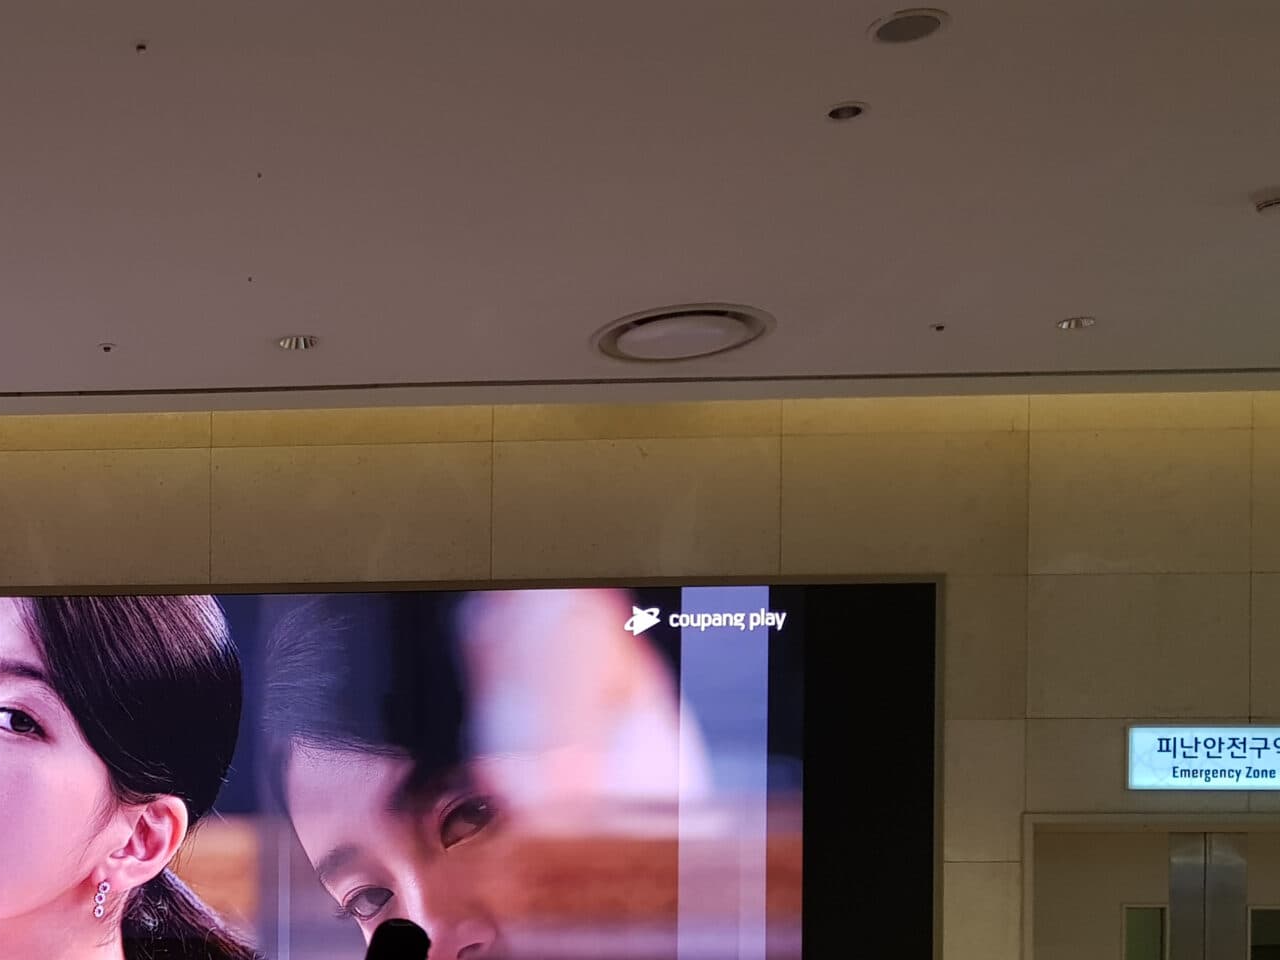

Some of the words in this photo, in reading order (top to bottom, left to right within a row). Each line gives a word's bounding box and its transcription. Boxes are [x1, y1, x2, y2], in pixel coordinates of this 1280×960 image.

[669, 612, 745, 632] coupang
[749, 608, 787, 632] play
[1172, 766, 1241, 782] Emergency
[1245, 766, 1276, 779] Zone
